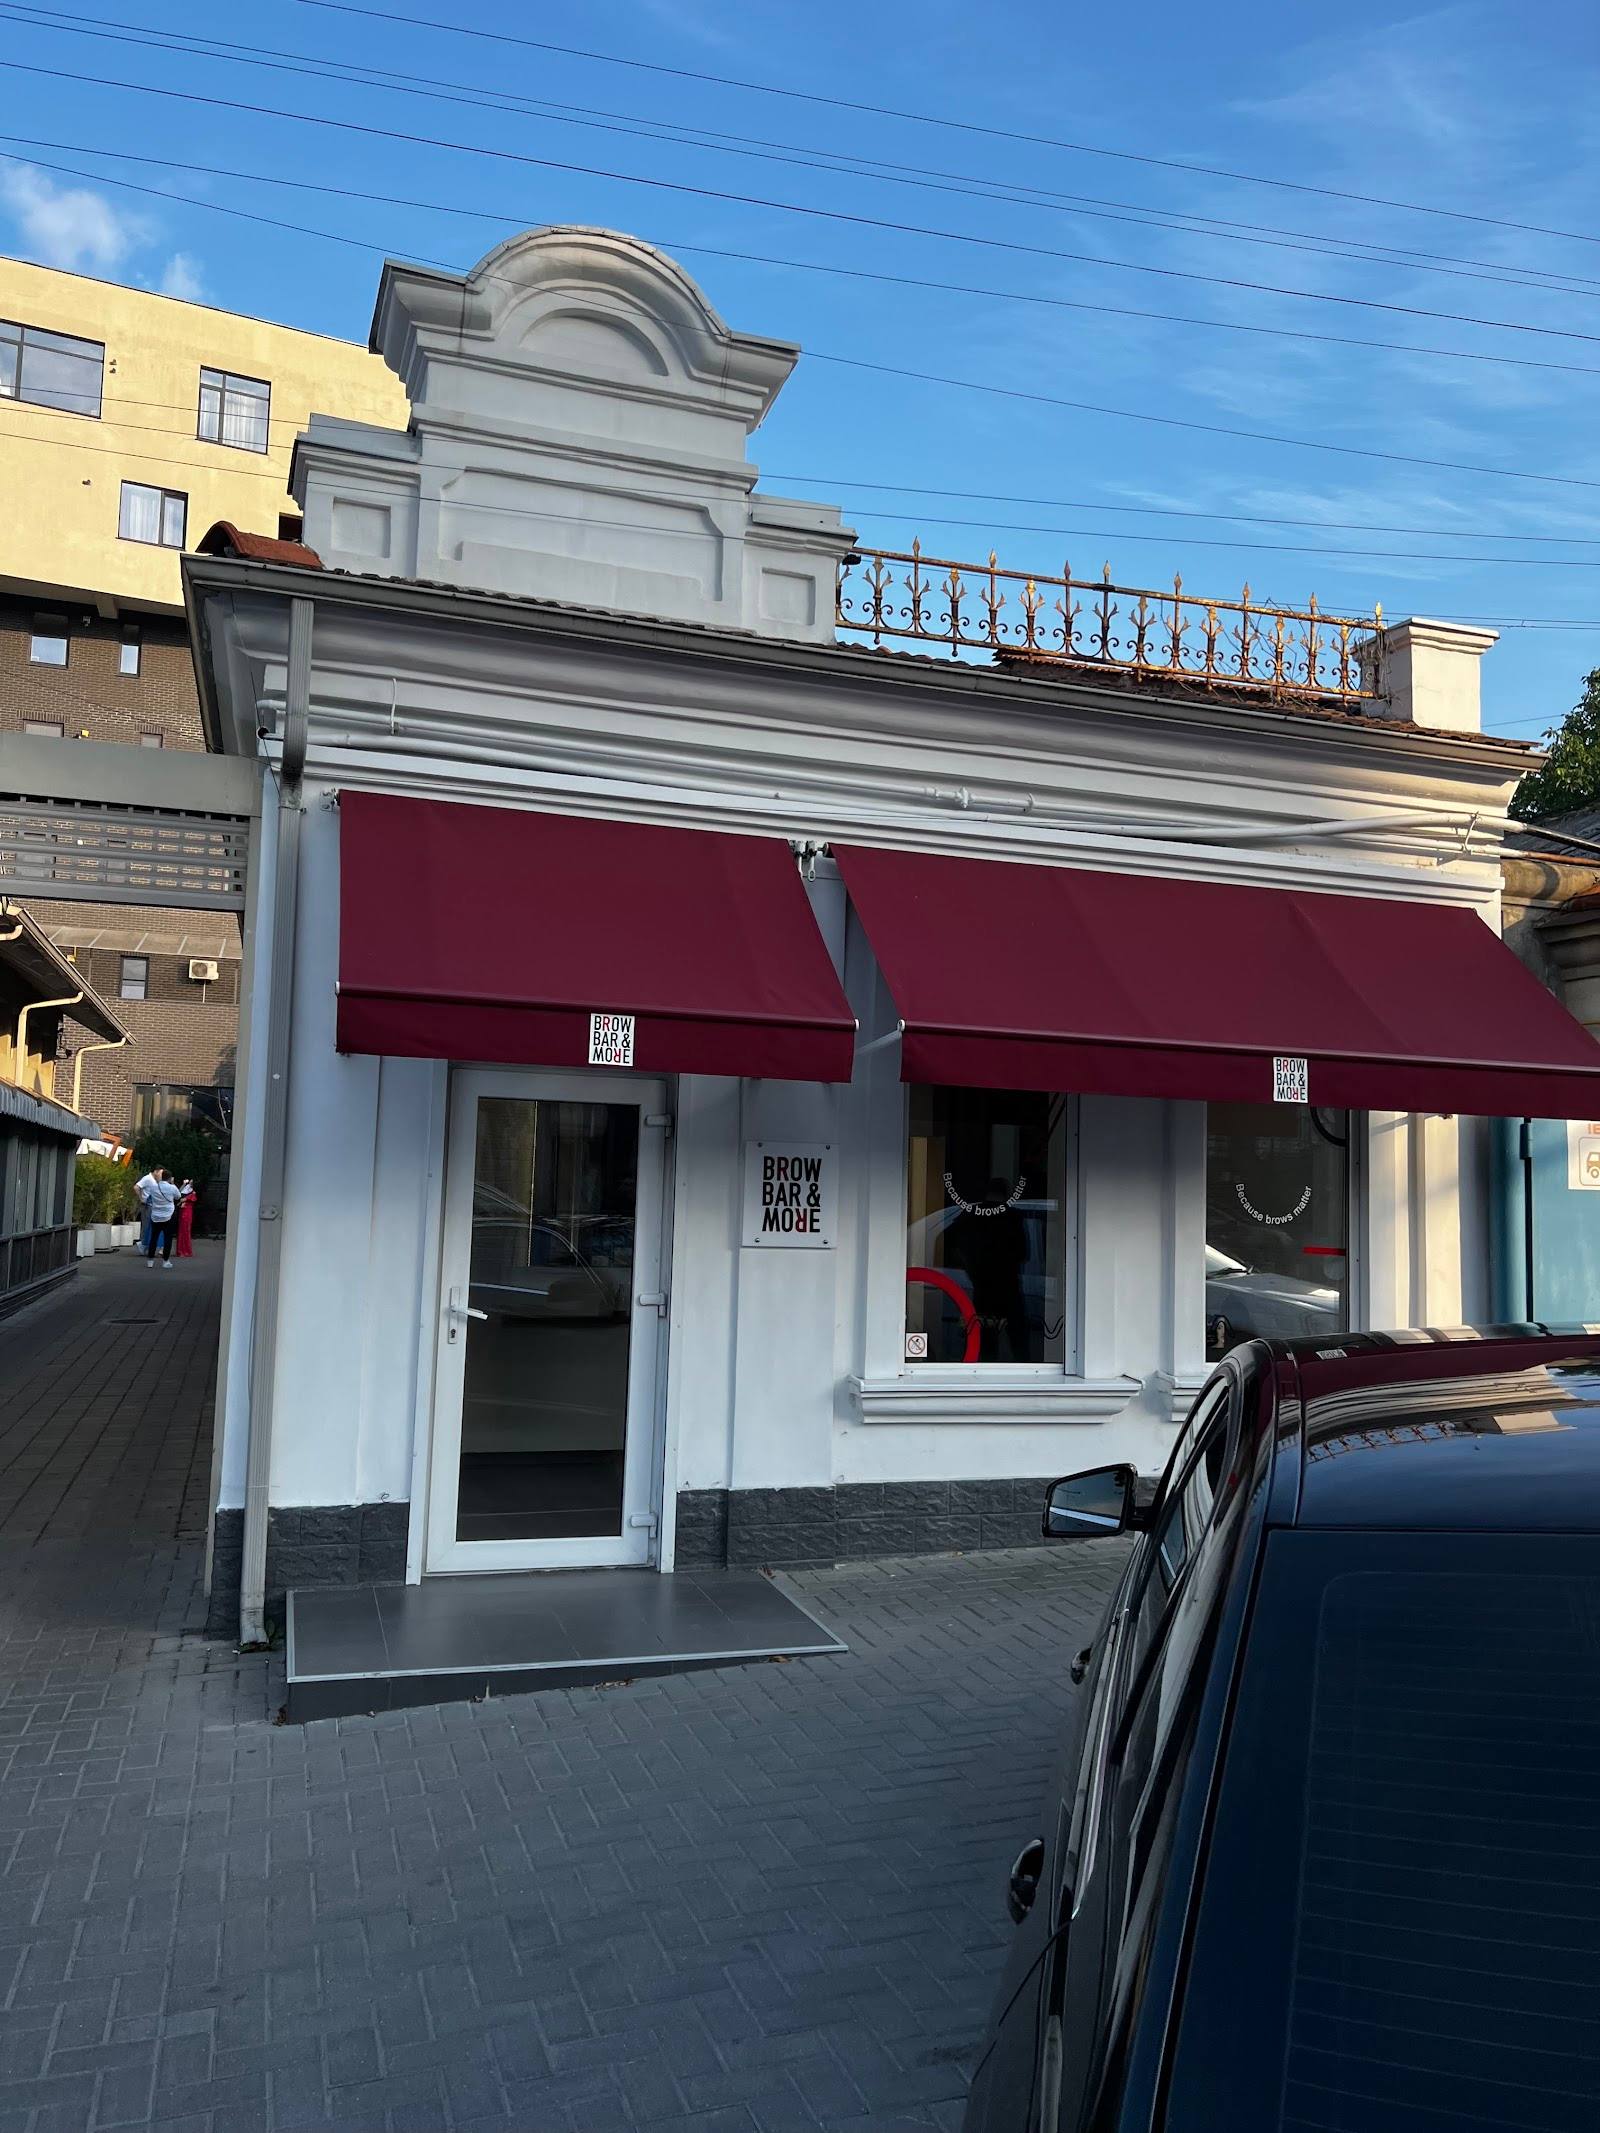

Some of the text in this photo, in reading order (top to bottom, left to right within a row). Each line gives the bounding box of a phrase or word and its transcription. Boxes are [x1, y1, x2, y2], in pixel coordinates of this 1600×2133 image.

[594, 1015, 632, 1033] BROW
[593, 1031, 631, 1049] BAR &
[592, 1046, 631, 1064] MORE
[1276, 1058, 1305, 1073] BROW
[1276, 1072, 1306, 1087] BAR &
[1276, 1086, 1306, 1101] MORE
[763, 1156, 822, 1183] BROW
[762, 1181, 821, 1208] BAR &
[943, 1172, 1027, 1217] Because brows matter
[1235, 1183, 1312, 1225] Because brows matter
[761, 1207, 821, 1233] MORE
